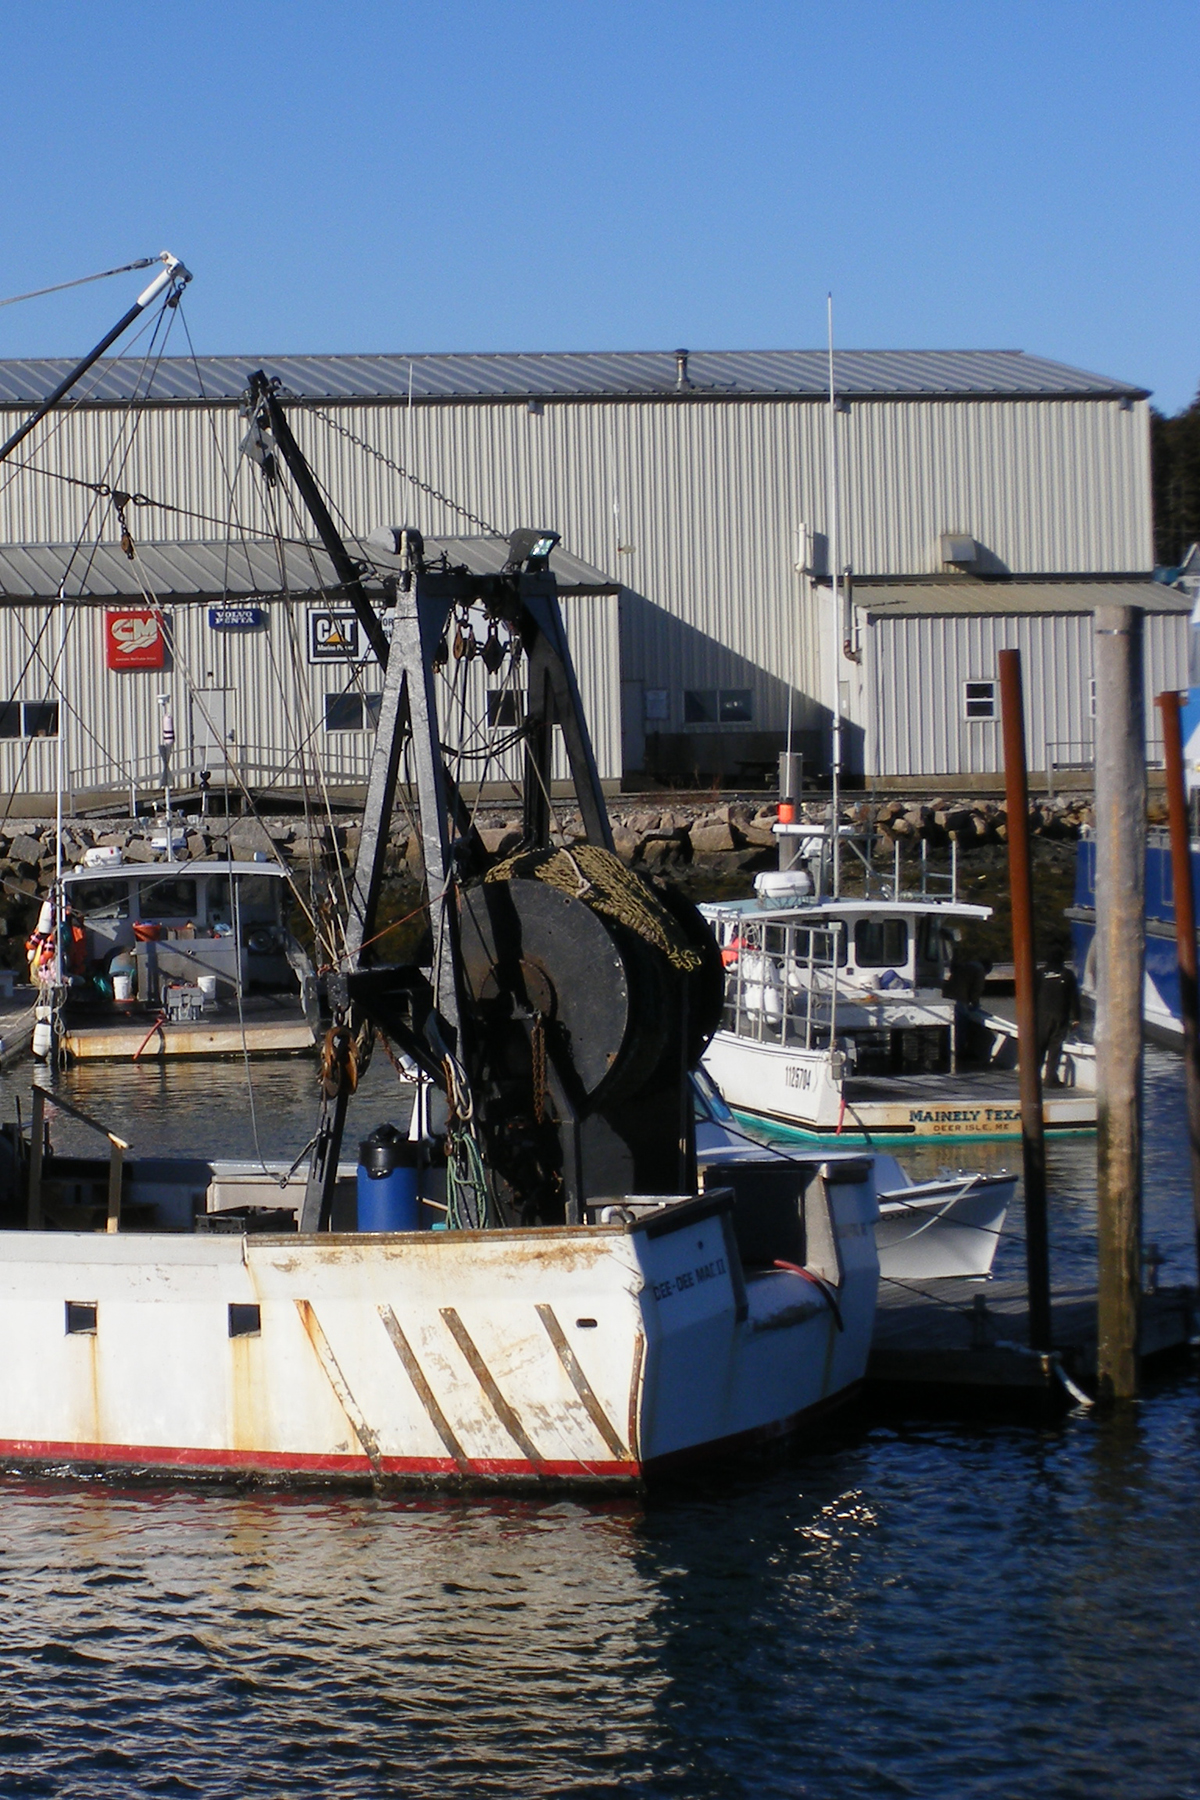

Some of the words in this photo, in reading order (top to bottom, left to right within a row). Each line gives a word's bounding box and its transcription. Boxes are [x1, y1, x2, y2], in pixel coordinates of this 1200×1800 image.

[316, 618, 355, 643] CAT
[909, 1110, 980, 1123] MAINELY
[984, 1109, 1022, 1122] TEXA
[933, 1124, 962, 1132] DEER
[995, 1123, 1010, 1131] ME
